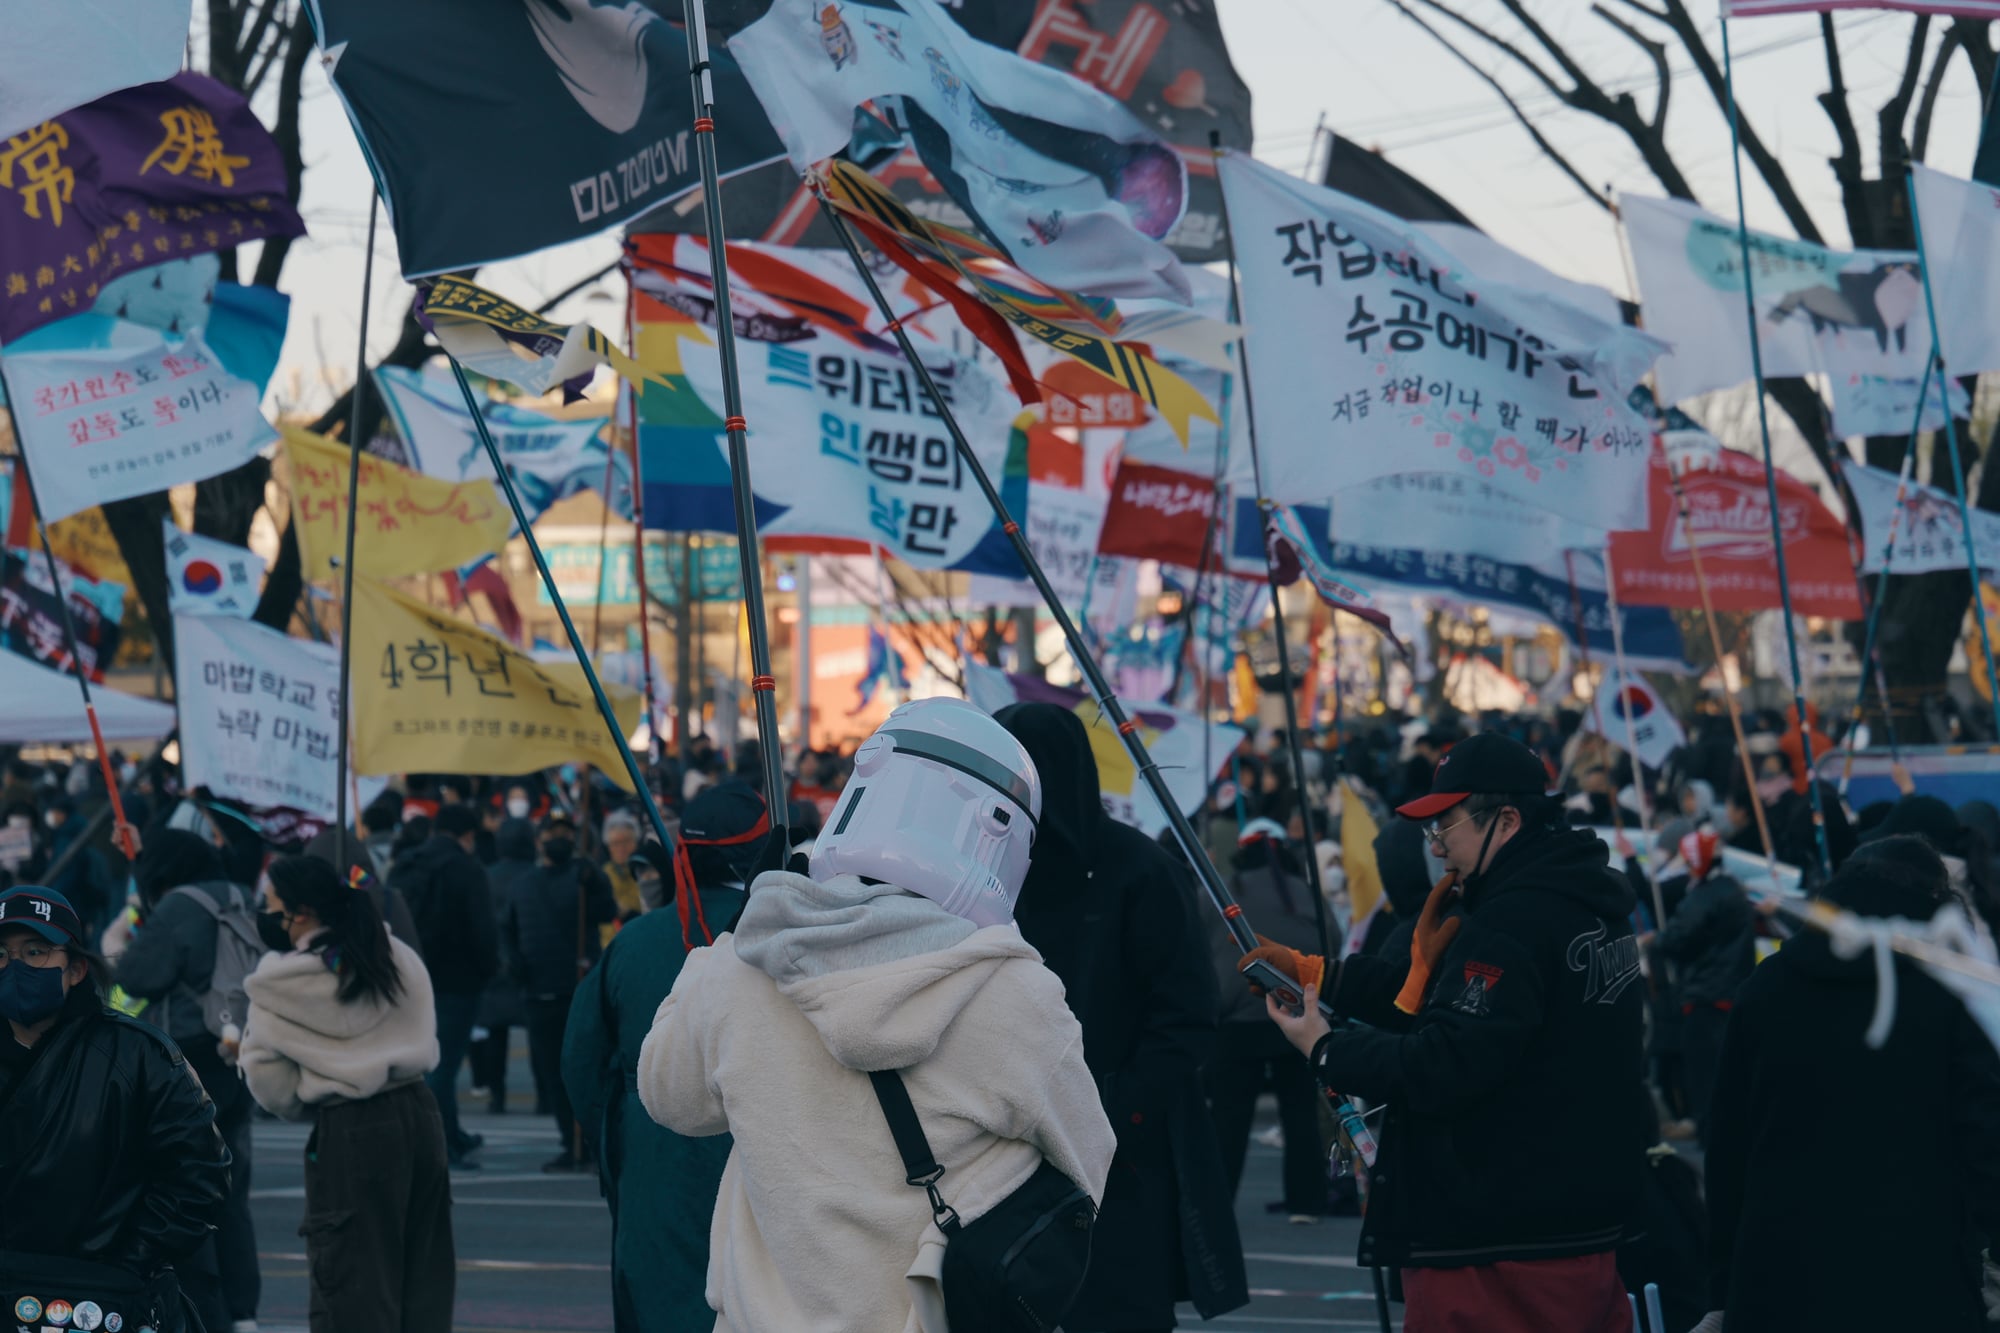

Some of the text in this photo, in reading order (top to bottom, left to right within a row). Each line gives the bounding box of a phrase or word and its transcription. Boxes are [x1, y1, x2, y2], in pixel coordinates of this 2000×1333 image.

[1332, 389, 1372, 423] 지금
[1380, 376, 1483, 416] 작업이나
[1496, 401, 1523, 431] 할
[1535, 417, 1590, 454] 때가
[819, 411, 963, 491] 인생의
[203, 660, 317, 712] 마법학교
[216, 708, 339, 763] 누락 마법
